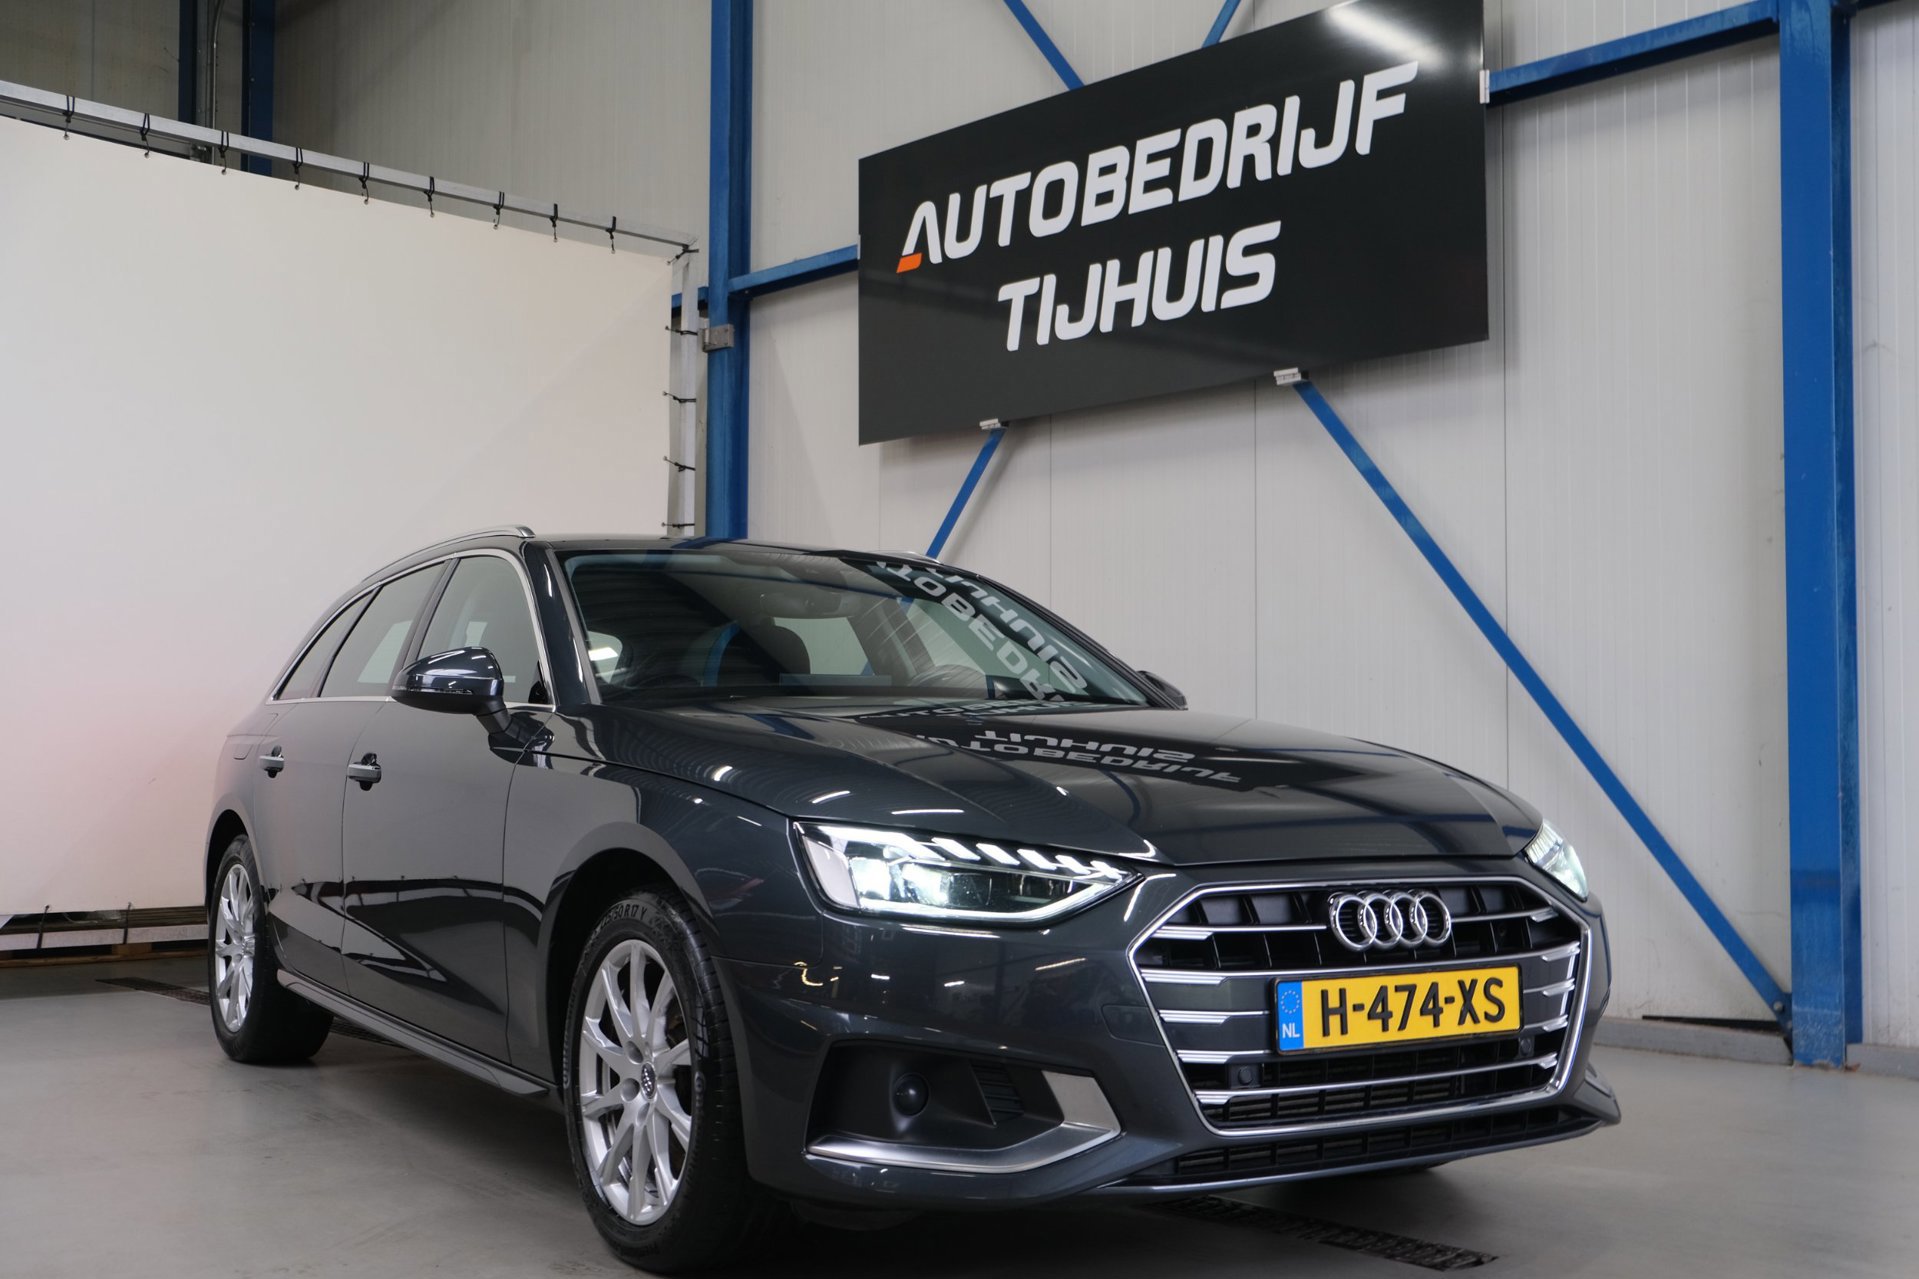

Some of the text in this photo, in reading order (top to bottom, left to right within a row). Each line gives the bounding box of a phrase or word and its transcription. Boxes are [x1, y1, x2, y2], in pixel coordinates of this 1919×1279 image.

[896, 61, 1419, 273] AUTOBEDRIJF
[998, 221, 1281, 352] TIJHUIS
[1282, 1023, 1300, 1039] NL
[1320, 977, 1506, 1037] H-474-XS
